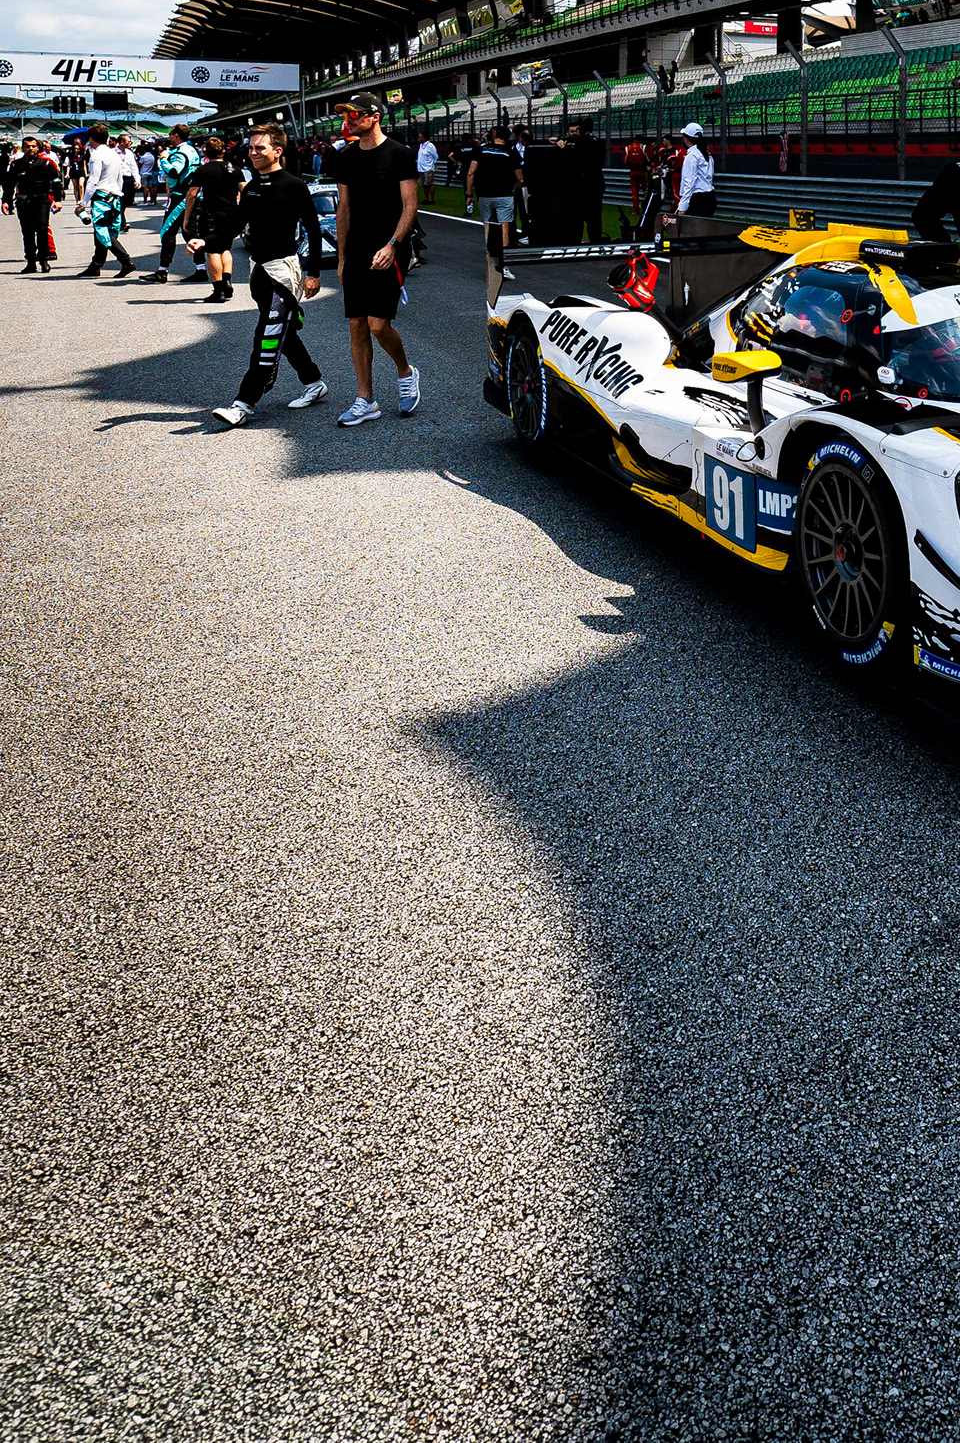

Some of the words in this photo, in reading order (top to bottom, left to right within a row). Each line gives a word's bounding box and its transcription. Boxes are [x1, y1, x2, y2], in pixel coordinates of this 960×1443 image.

[51, 59, 97, 82] 4H
[100, 60, 113, 68] OF
[97, 69, 157, 83] SEPANG
[220, 74, 231, 82] LE
[233, 75, 260, 83] MANS
[539, 310, 589, 356] PURE
[716, 442, 722, 451] LE
[722, 445, 734, 457] MANS
[820, 444, 860, 464] MICHELIN
[713, 465, 744, 540] 91
[842, 641, 882, 664] MICHELIN
